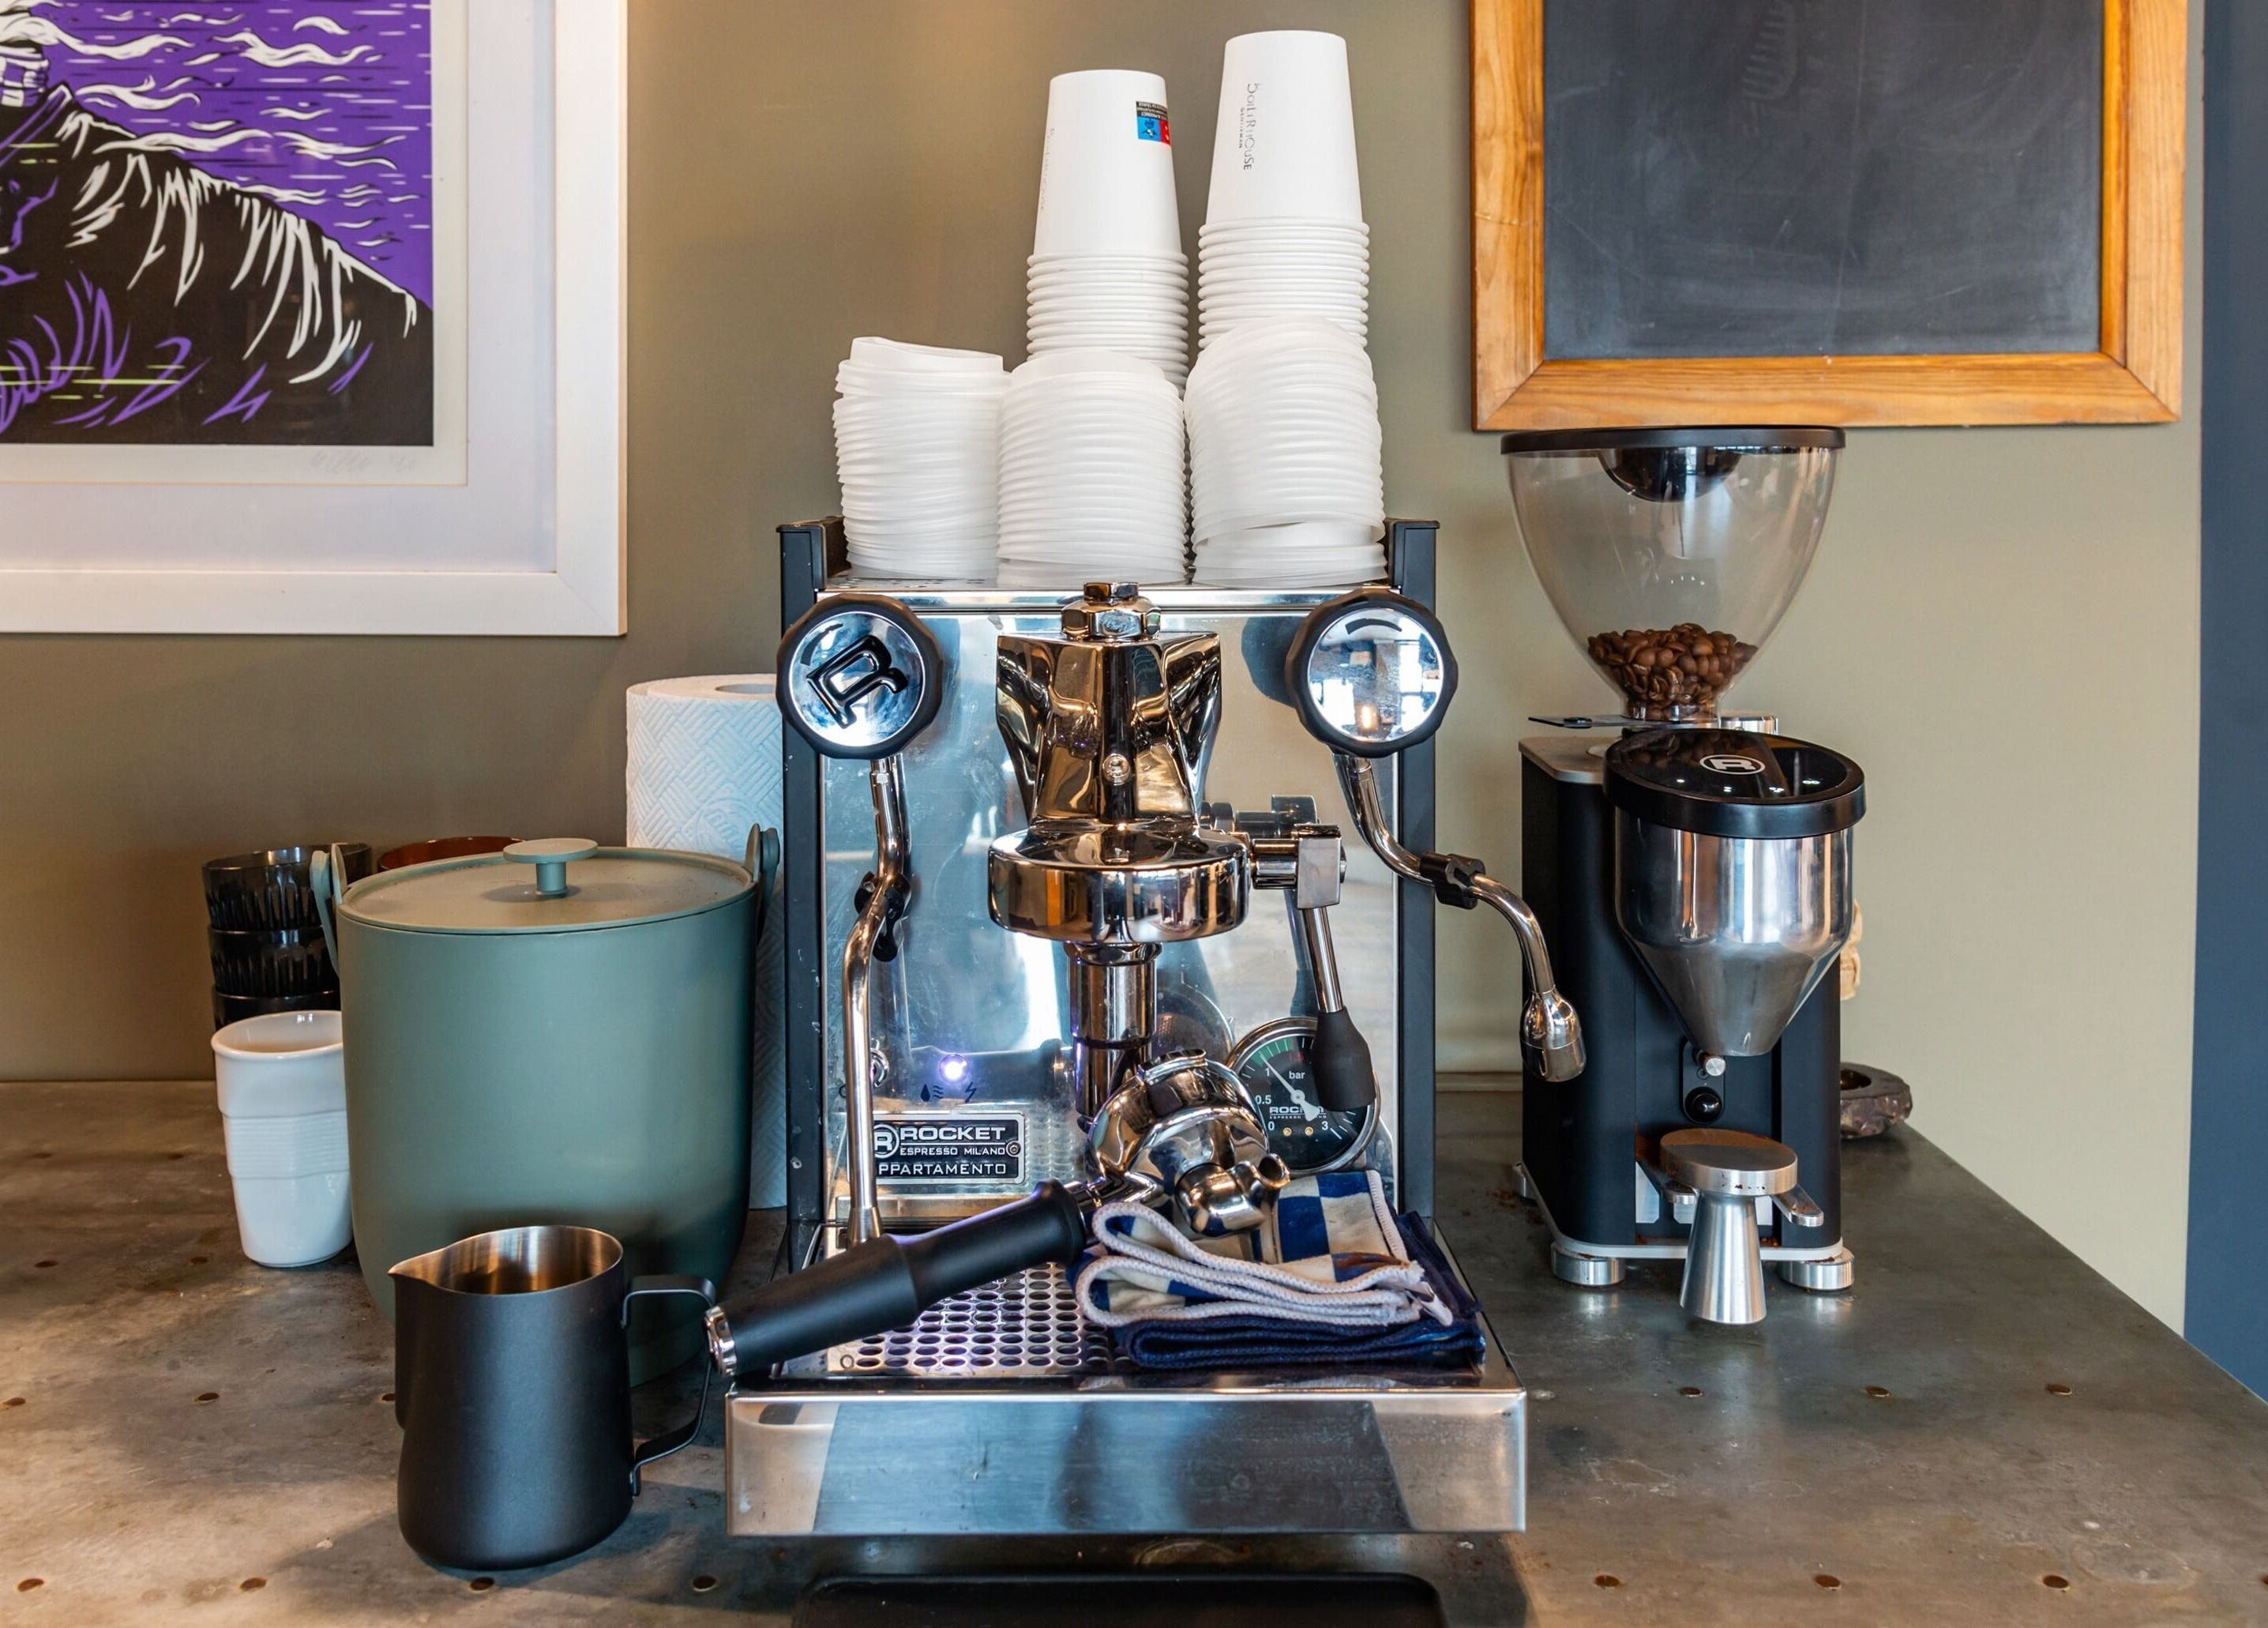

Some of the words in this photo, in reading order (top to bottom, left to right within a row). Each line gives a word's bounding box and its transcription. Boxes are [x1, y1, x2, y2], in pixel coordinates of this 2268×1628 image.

[1710, 758, 1757, 770] R
[1264, 1068, 1270, 1077] 1
[1289, 1070, 1305, 1080] bar
[1255, 1095, 1271, 1104] 0.5
[1267, 1121, 1275, 1131] 0
[1321, 1120, 1328, 1130] 3
[900, 1126, 1005, 1140] ROCKET
[900, 1147, 958, 1156] ESPRESSO
[963, 1147, 1005, 1156] MILANO
[878, 1164, 1006, 1175] PPARTAMENTO
